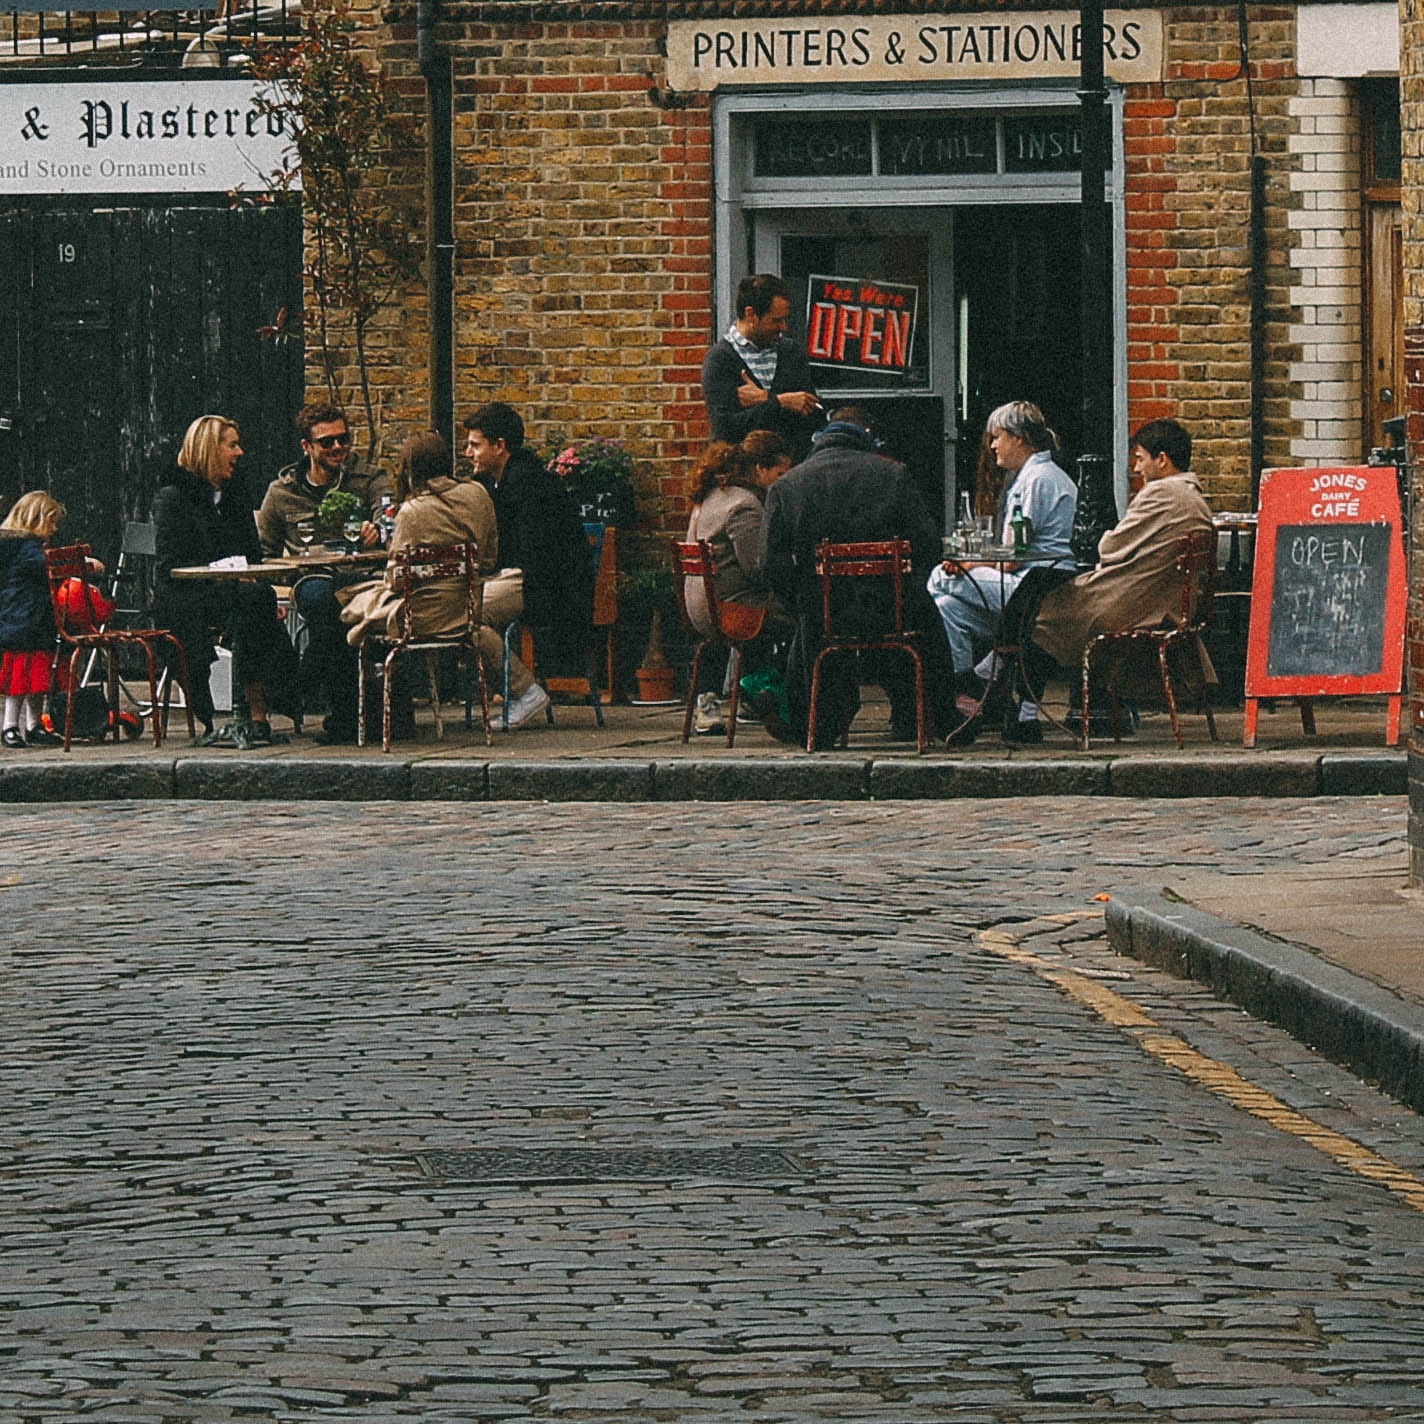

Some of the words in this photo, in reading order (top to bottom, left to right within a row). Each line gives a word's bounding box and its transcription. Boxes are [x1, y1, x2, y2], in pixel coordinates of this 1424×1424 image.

[693, 28, 871, 69] PRINTERS
[884, 31, 906, 66] &
[20, 106, 51, 142] &
[36, 158, 93, 179] Stone
[99, 157, 207, 178] Ornaments
[58, 243, 75, 263] 19
[808, 302, 910, 367] OPEN
[1309, 473, 1367, 492] JONES
[1321, 491, 1352, 501] DAIRY
[1311, 498, 1360, 518] CAFÉ
[1291, 535, 1366, 566] OPEN
